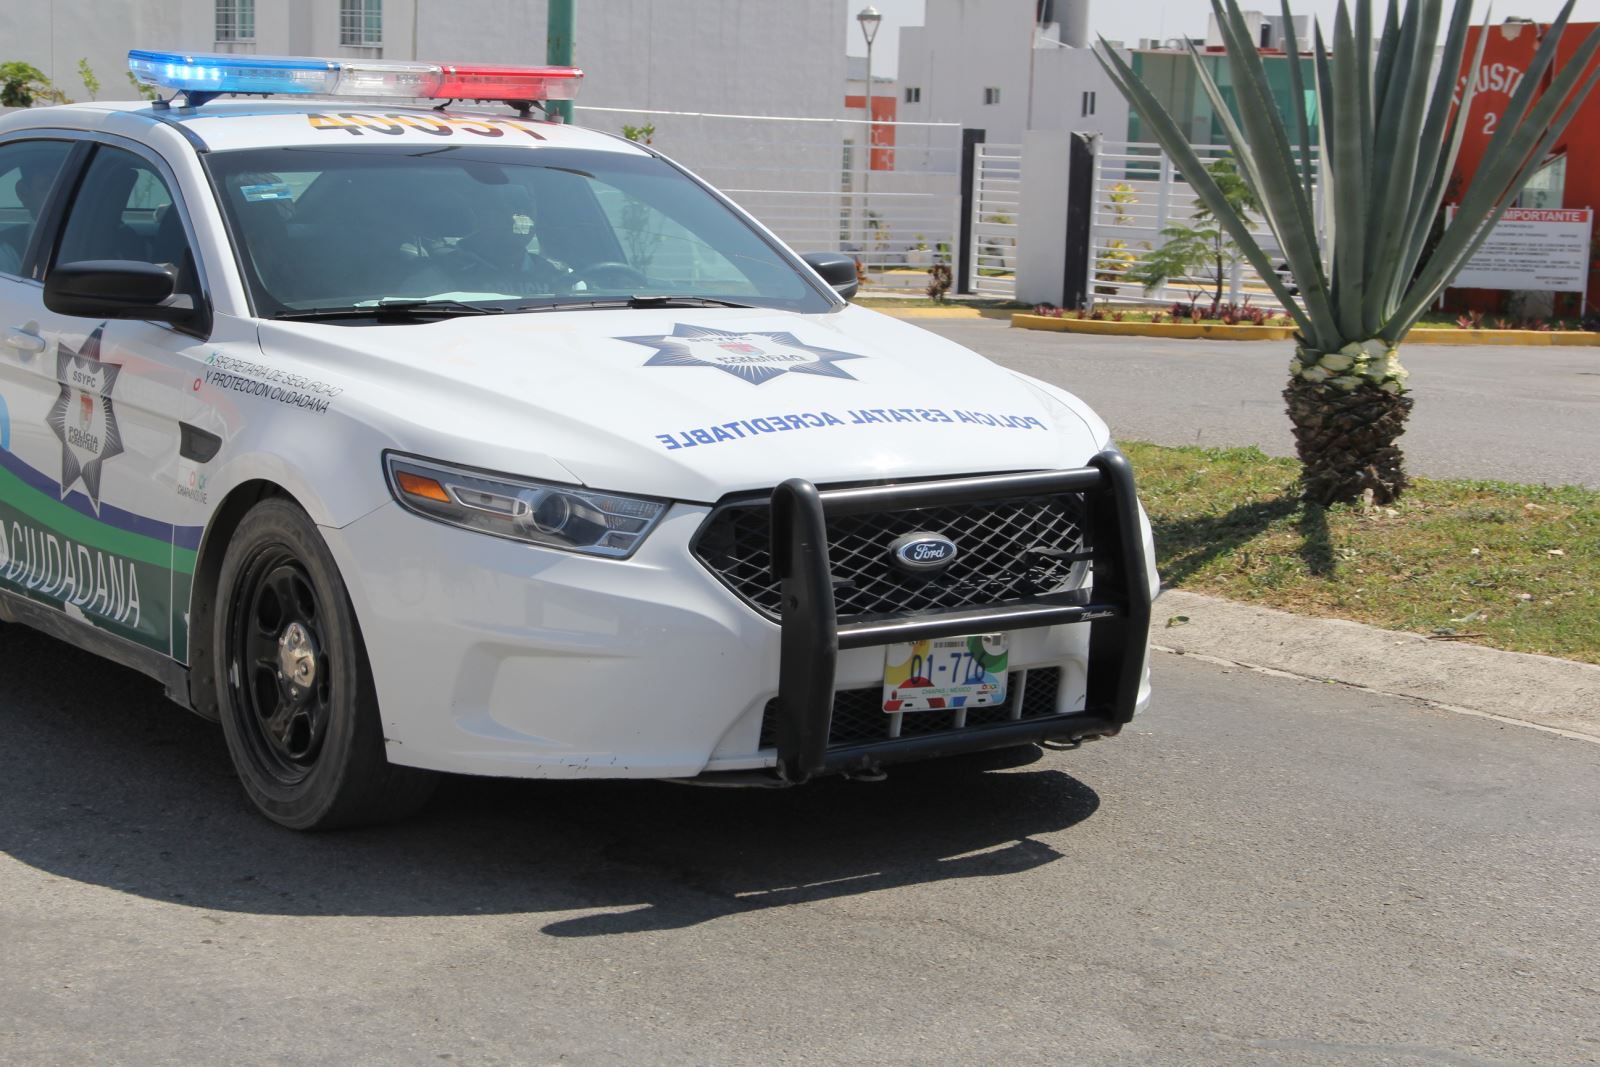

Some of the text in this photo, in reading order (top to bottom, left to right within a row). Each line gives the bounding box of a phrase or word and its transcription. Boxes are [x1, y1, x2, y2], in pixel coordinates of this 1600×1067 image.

[307, 113, 547, 141] 40051
[1482, 112, 1497, 134] 2
[1503, 210, 1580, 222] MPORTANTE
[72, 370, 96, 388] SSYPC
[205, 370, 213, 384] Y
[271, 387, 330, 413] CIUDADANA
[913, 543, 945, 560] Ford
[6, 521, 140, 628] CIUDADANA
